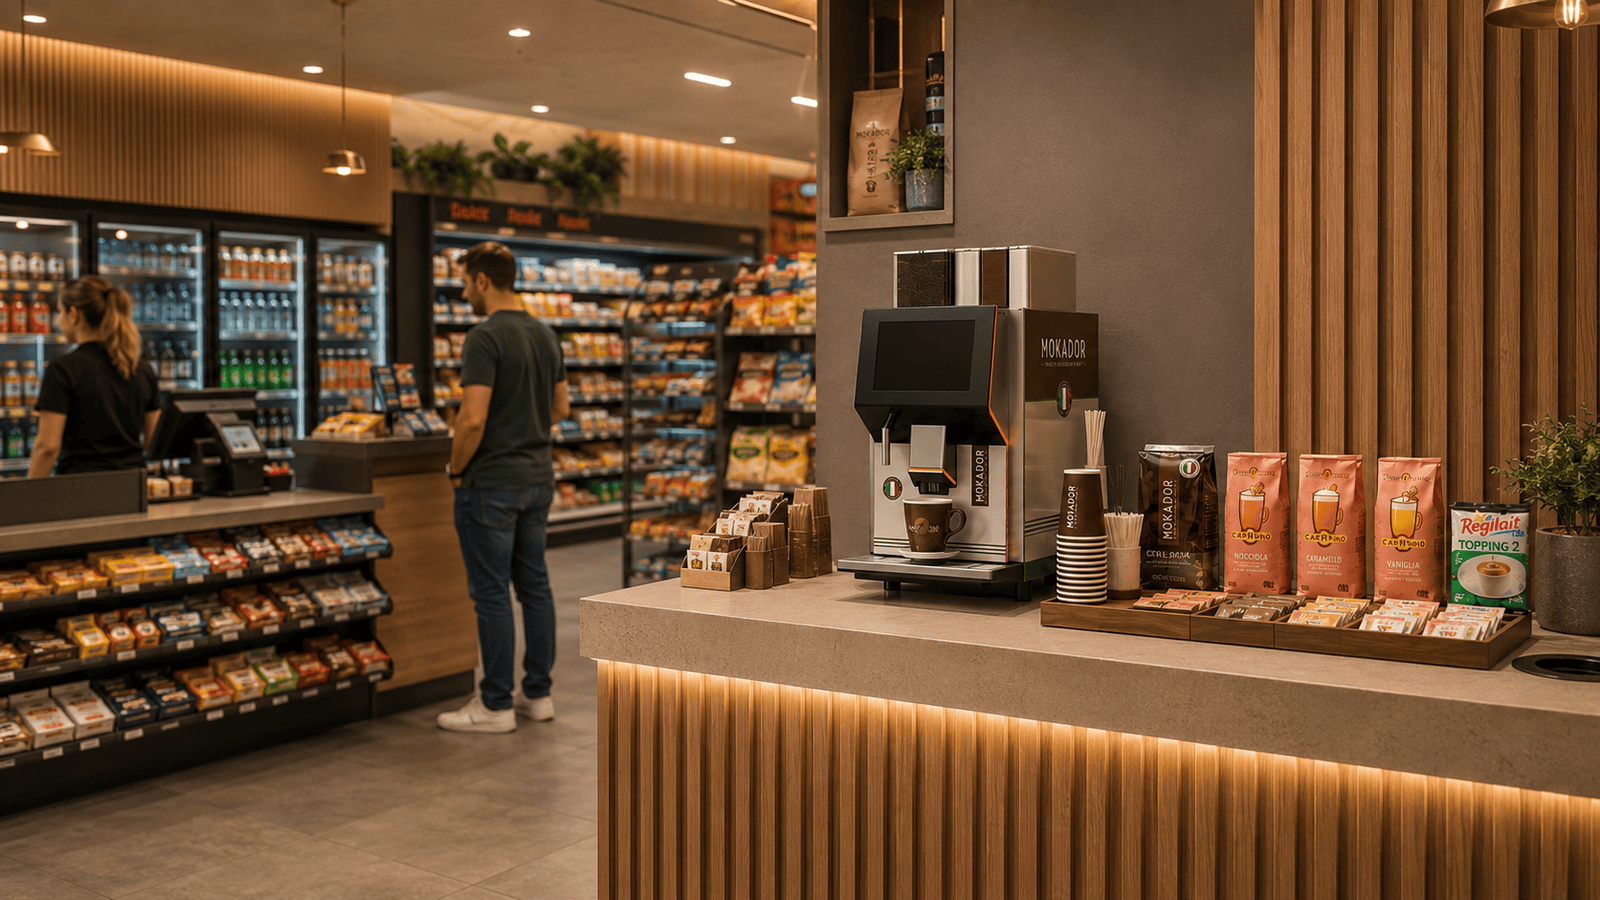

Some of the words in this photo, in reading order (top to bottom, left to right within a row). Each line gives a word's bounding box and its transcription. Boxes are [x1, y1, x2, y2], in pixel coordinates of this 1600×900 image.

[1041, 338, 1086, 359] MOKADOR
[975, 450, 985, 502] MOKADOR
[1162, 480, 1173, 540] MOKADOR
[1460, 515, 1521, 537] Regilait
[1458, 539, 1509, 552] TOPPING
[1512, 541, 1520, 552] 2
[1386, 560, 1420, 569] VANIGLIA
